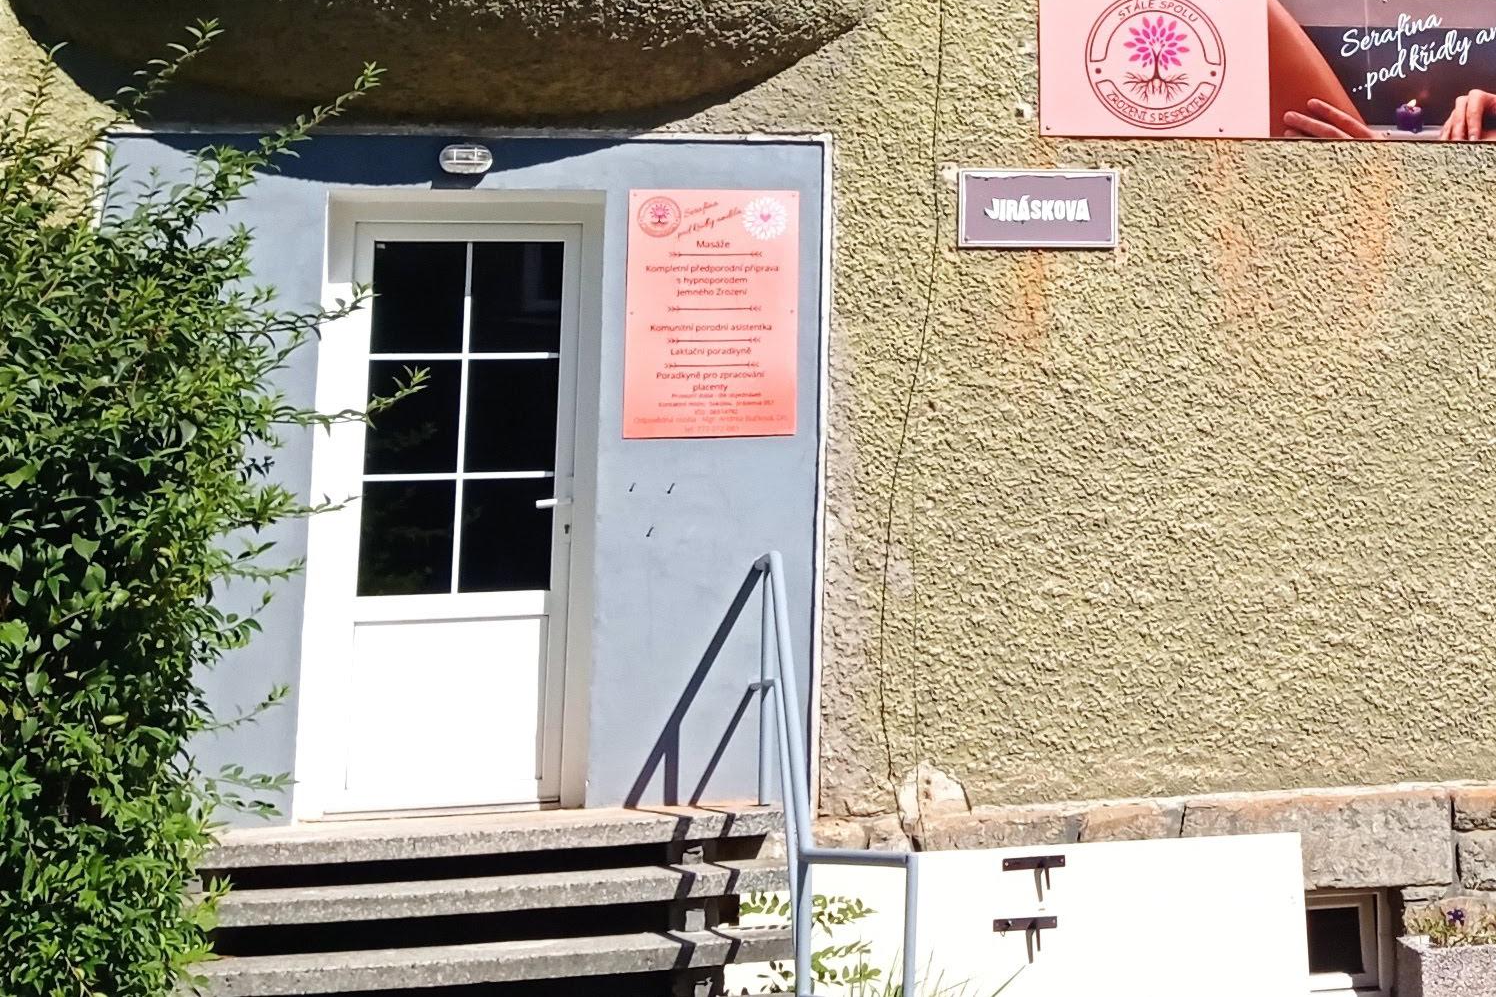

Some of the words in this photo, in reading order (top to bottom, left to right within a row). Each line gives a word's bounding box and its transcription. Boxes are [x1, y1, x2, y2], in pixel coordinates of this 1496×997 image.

[1159, 0, 1199, 23] SPOLU
[1340, 13, 1443, 58] Serafina
[1409, 29, 1472, 72] křídly
[1150, 112, 1156, 122] S
[984, 194, 1091, 222] JIRÁSKOVA
[696, 239, 731, 249] Masáže
[645, 264, 689, 274] Kompletní
[690, 264, 743, 274] předporodní
[683, 276, 748, 286] hypnoporodem
[650, 323, 694, 332] Komunitní
[731, 322, 773, 331] asistentka
[707, 346, 752, 357] poradkyně
[656, 371, 701, 381] Poradkyně
[702, 372, 719, 381] pro
